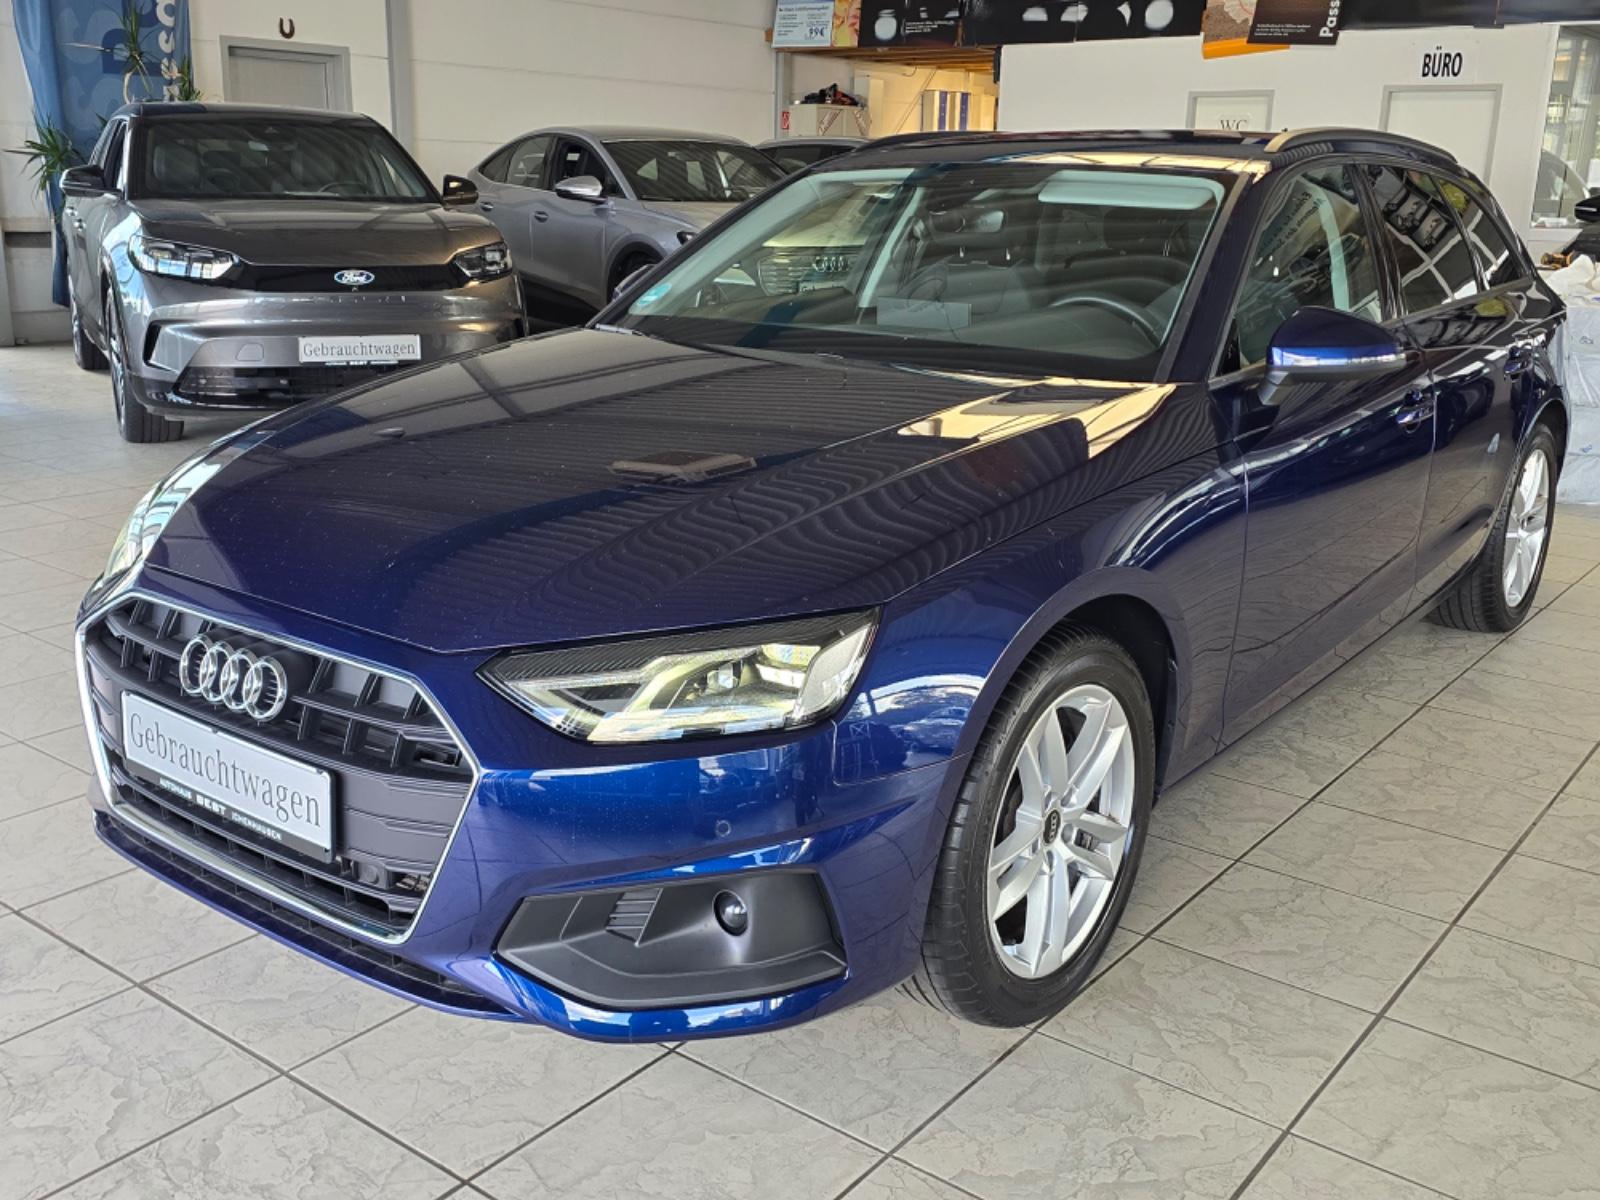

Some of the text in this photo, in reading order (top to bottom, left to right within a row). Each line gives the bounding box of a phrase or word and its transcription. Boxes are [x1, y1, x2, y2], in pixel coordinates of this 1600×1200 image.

[1421, 45, 1463, 77] BÜRO
[303, 343, 415, 357] Gebrauchtwagen
[129, 713, 321, 828] Gebrauchtwagen
